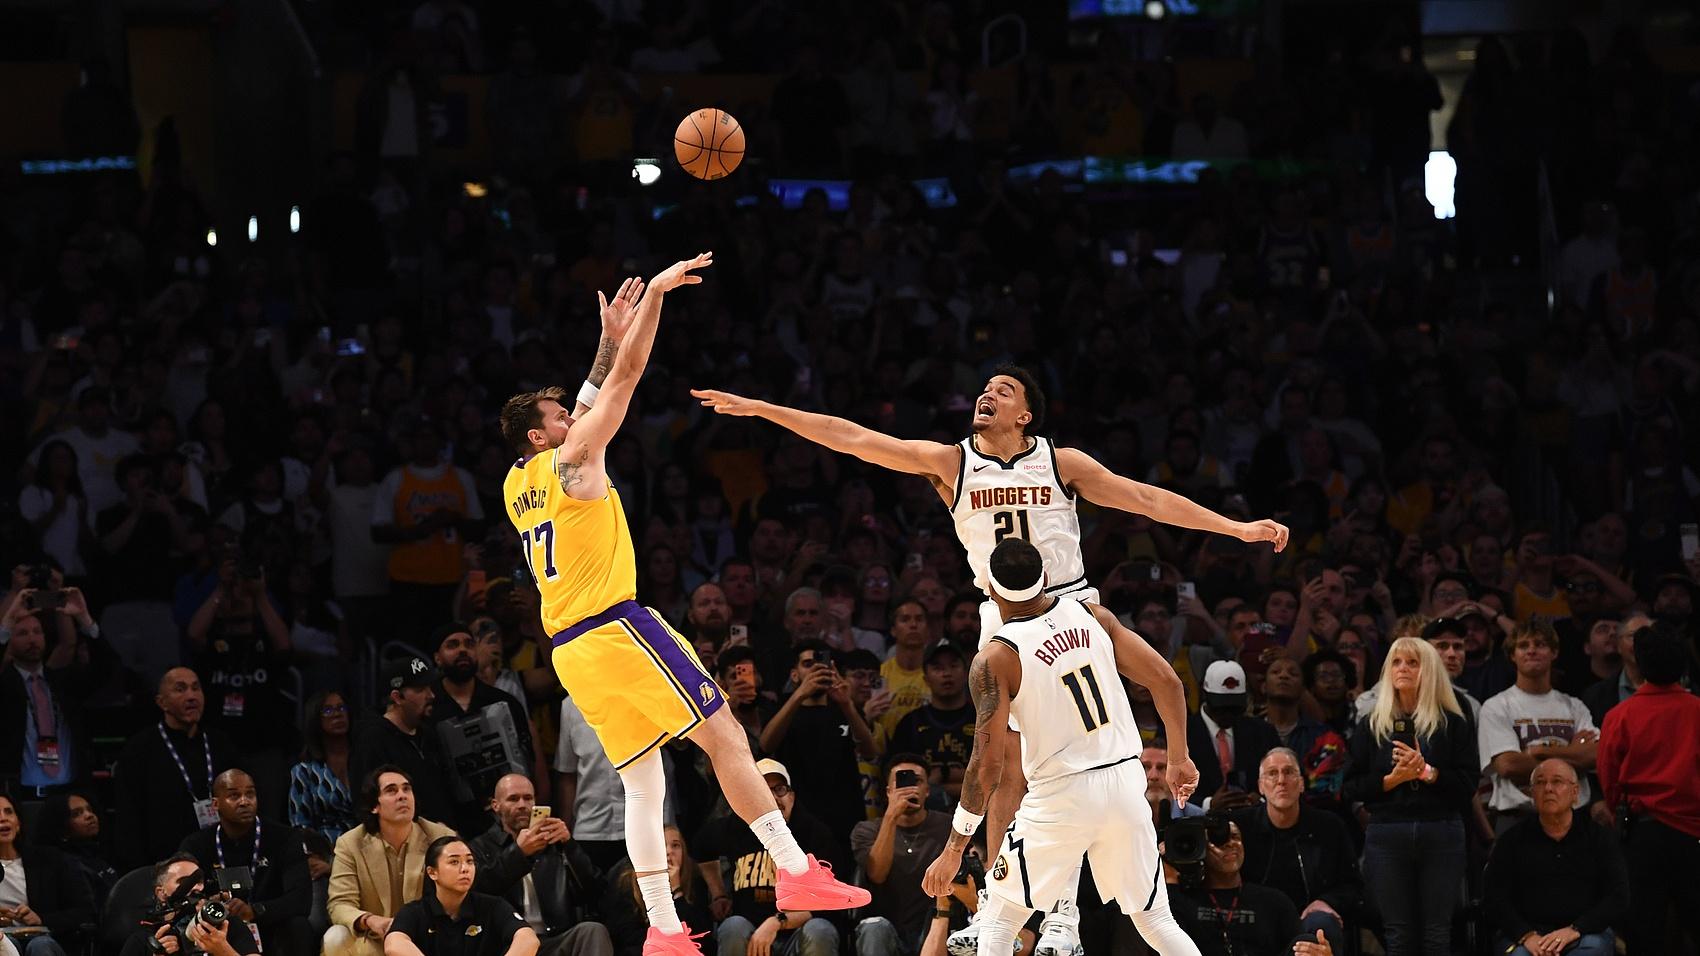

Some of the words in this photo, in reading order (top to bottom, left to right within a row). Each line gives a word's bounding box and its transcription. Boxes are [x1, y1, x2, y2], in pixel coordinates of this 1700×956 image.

[513, 486, 547, 519] DONČIĆ
[969, 486, 1052, 510] NUGGETS
[993, 509, 1031, 546] 21
[1034, 628, 1090, 667] BROWN
[1060, 664, 1110, 733] 11
